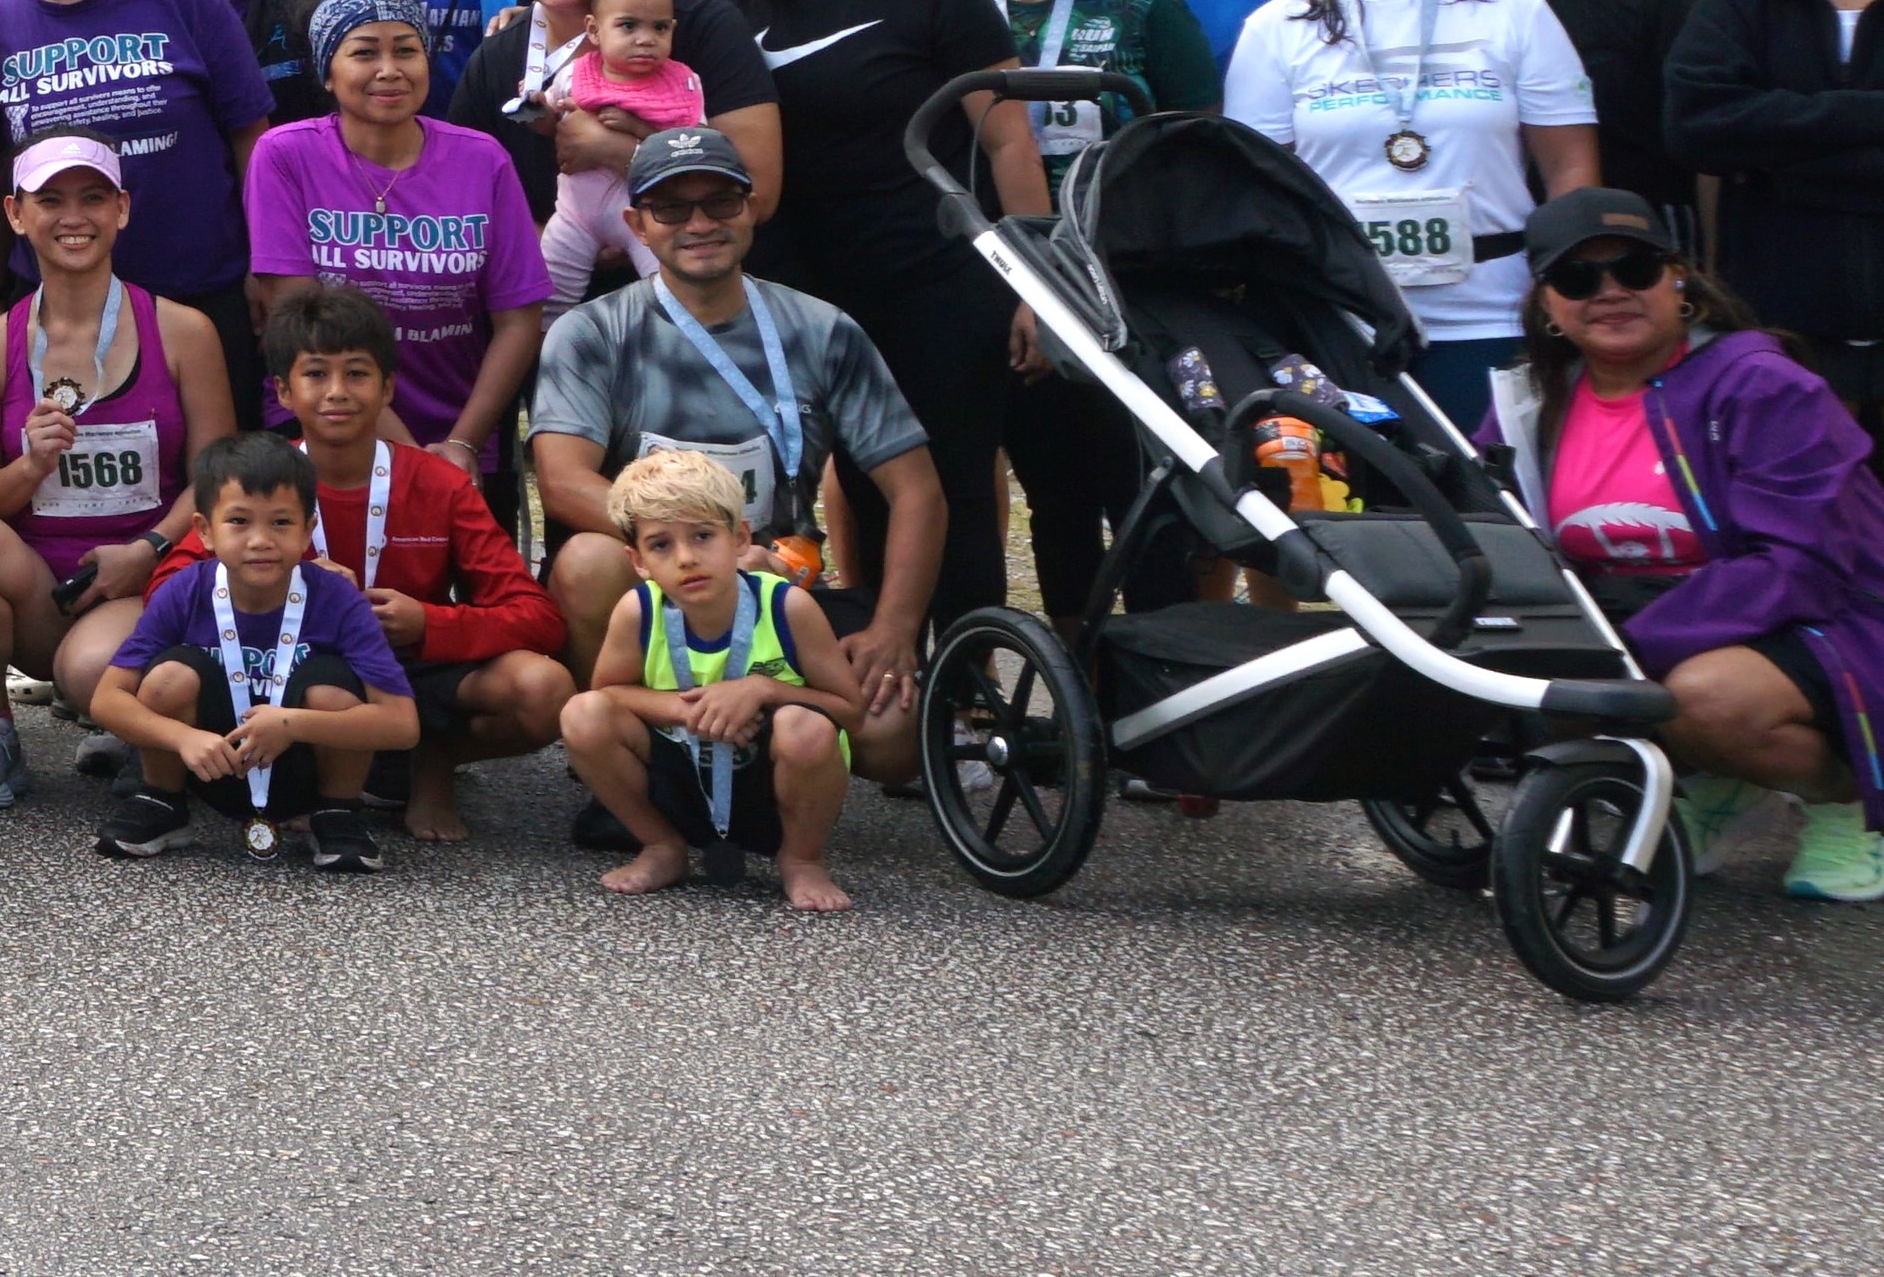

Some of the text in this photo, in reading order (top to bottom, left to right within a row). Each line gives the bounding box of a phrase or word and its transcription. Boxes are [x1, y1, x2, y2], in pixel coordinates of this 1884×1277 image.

[2, 32, 170, 87] SUPPORT
[36, 60, 174, 95] SURVIVORS
[308, 208, 490, 253] SUPPORT
[1361, 217, 1452, 257] 588
[354, 248, 488, 274] SURVIVORS
[407, 321, 473, 343] BLAMIN
[58, 450, 143, 489] 1568
